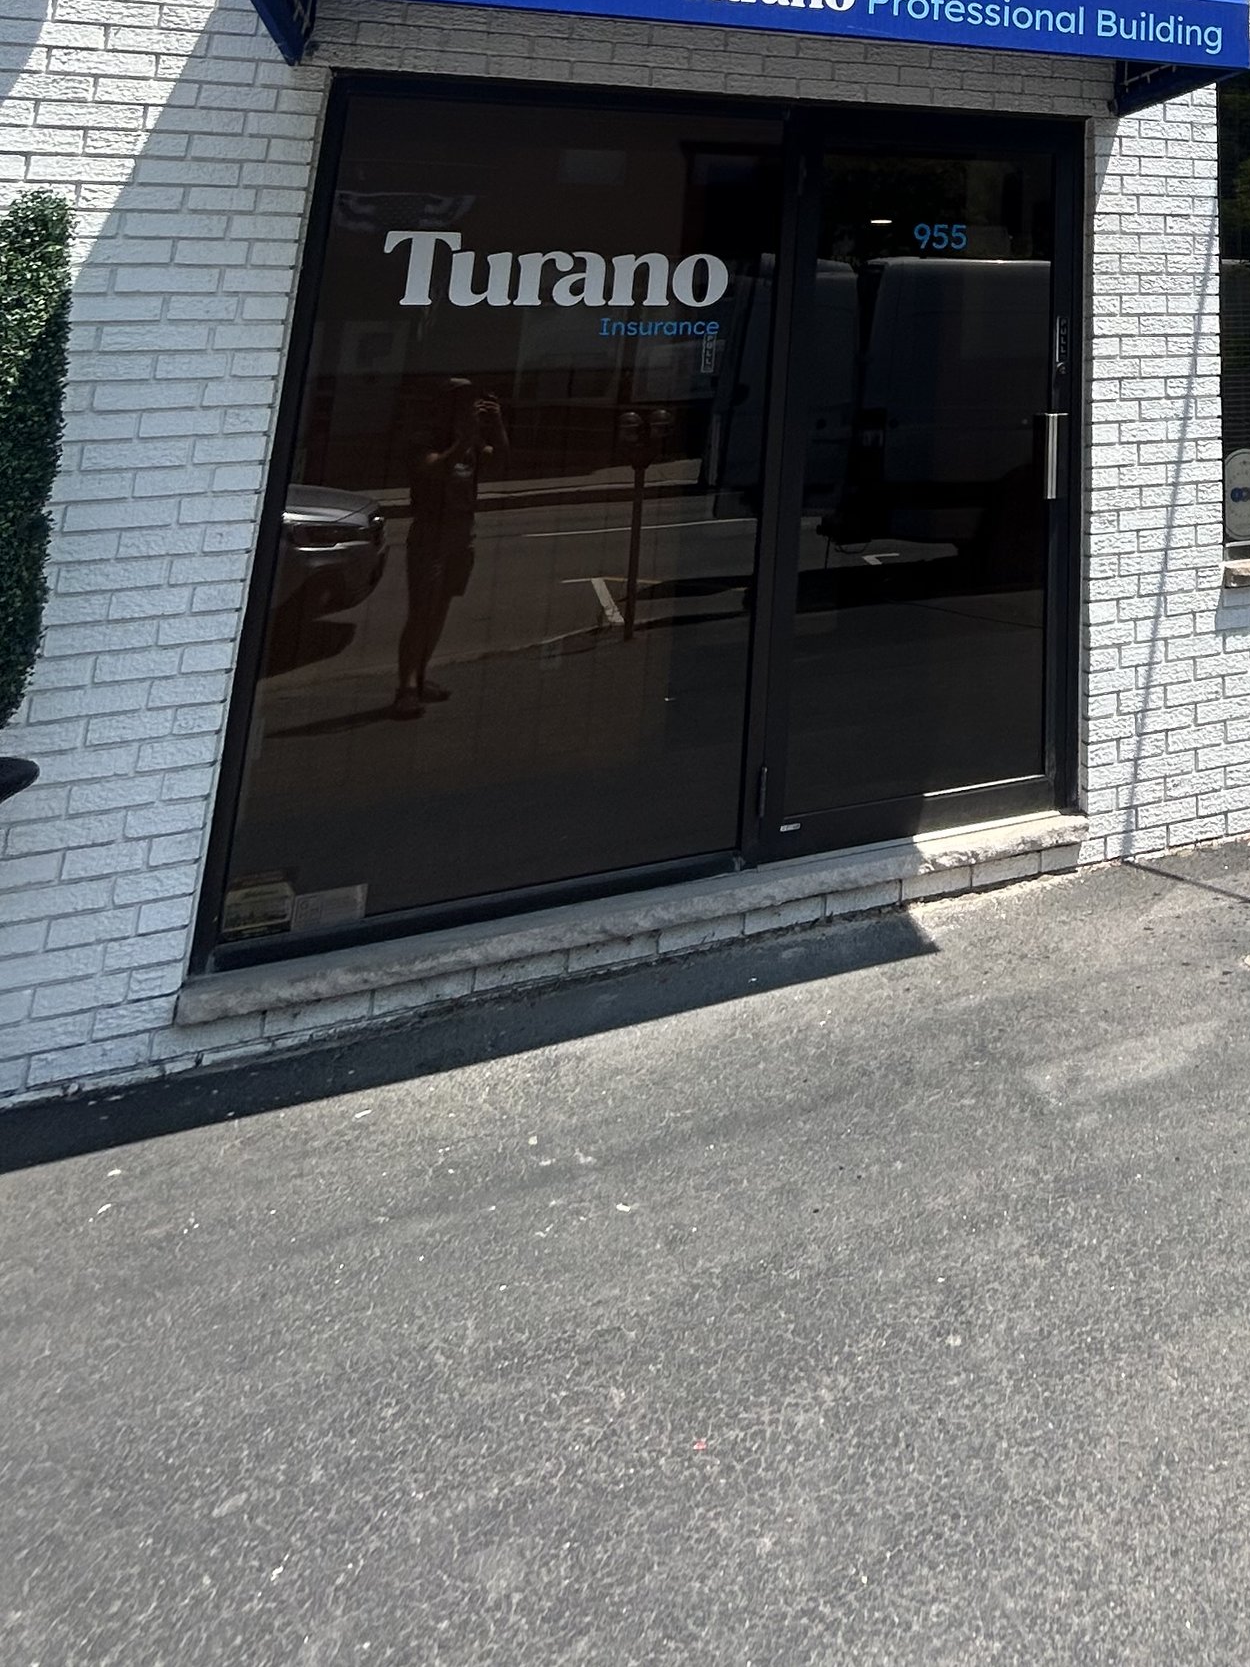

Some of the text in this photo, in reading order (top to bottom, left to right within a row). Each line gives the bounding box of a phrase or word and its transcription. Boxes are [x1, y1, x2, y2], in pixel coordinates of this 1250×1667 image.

[1097, 9, 1223, 54] Building
[913, 223, 967, 250] 955
[384, 230, 729, 308] Turano
[599, 317, 720, 336] Insurance
